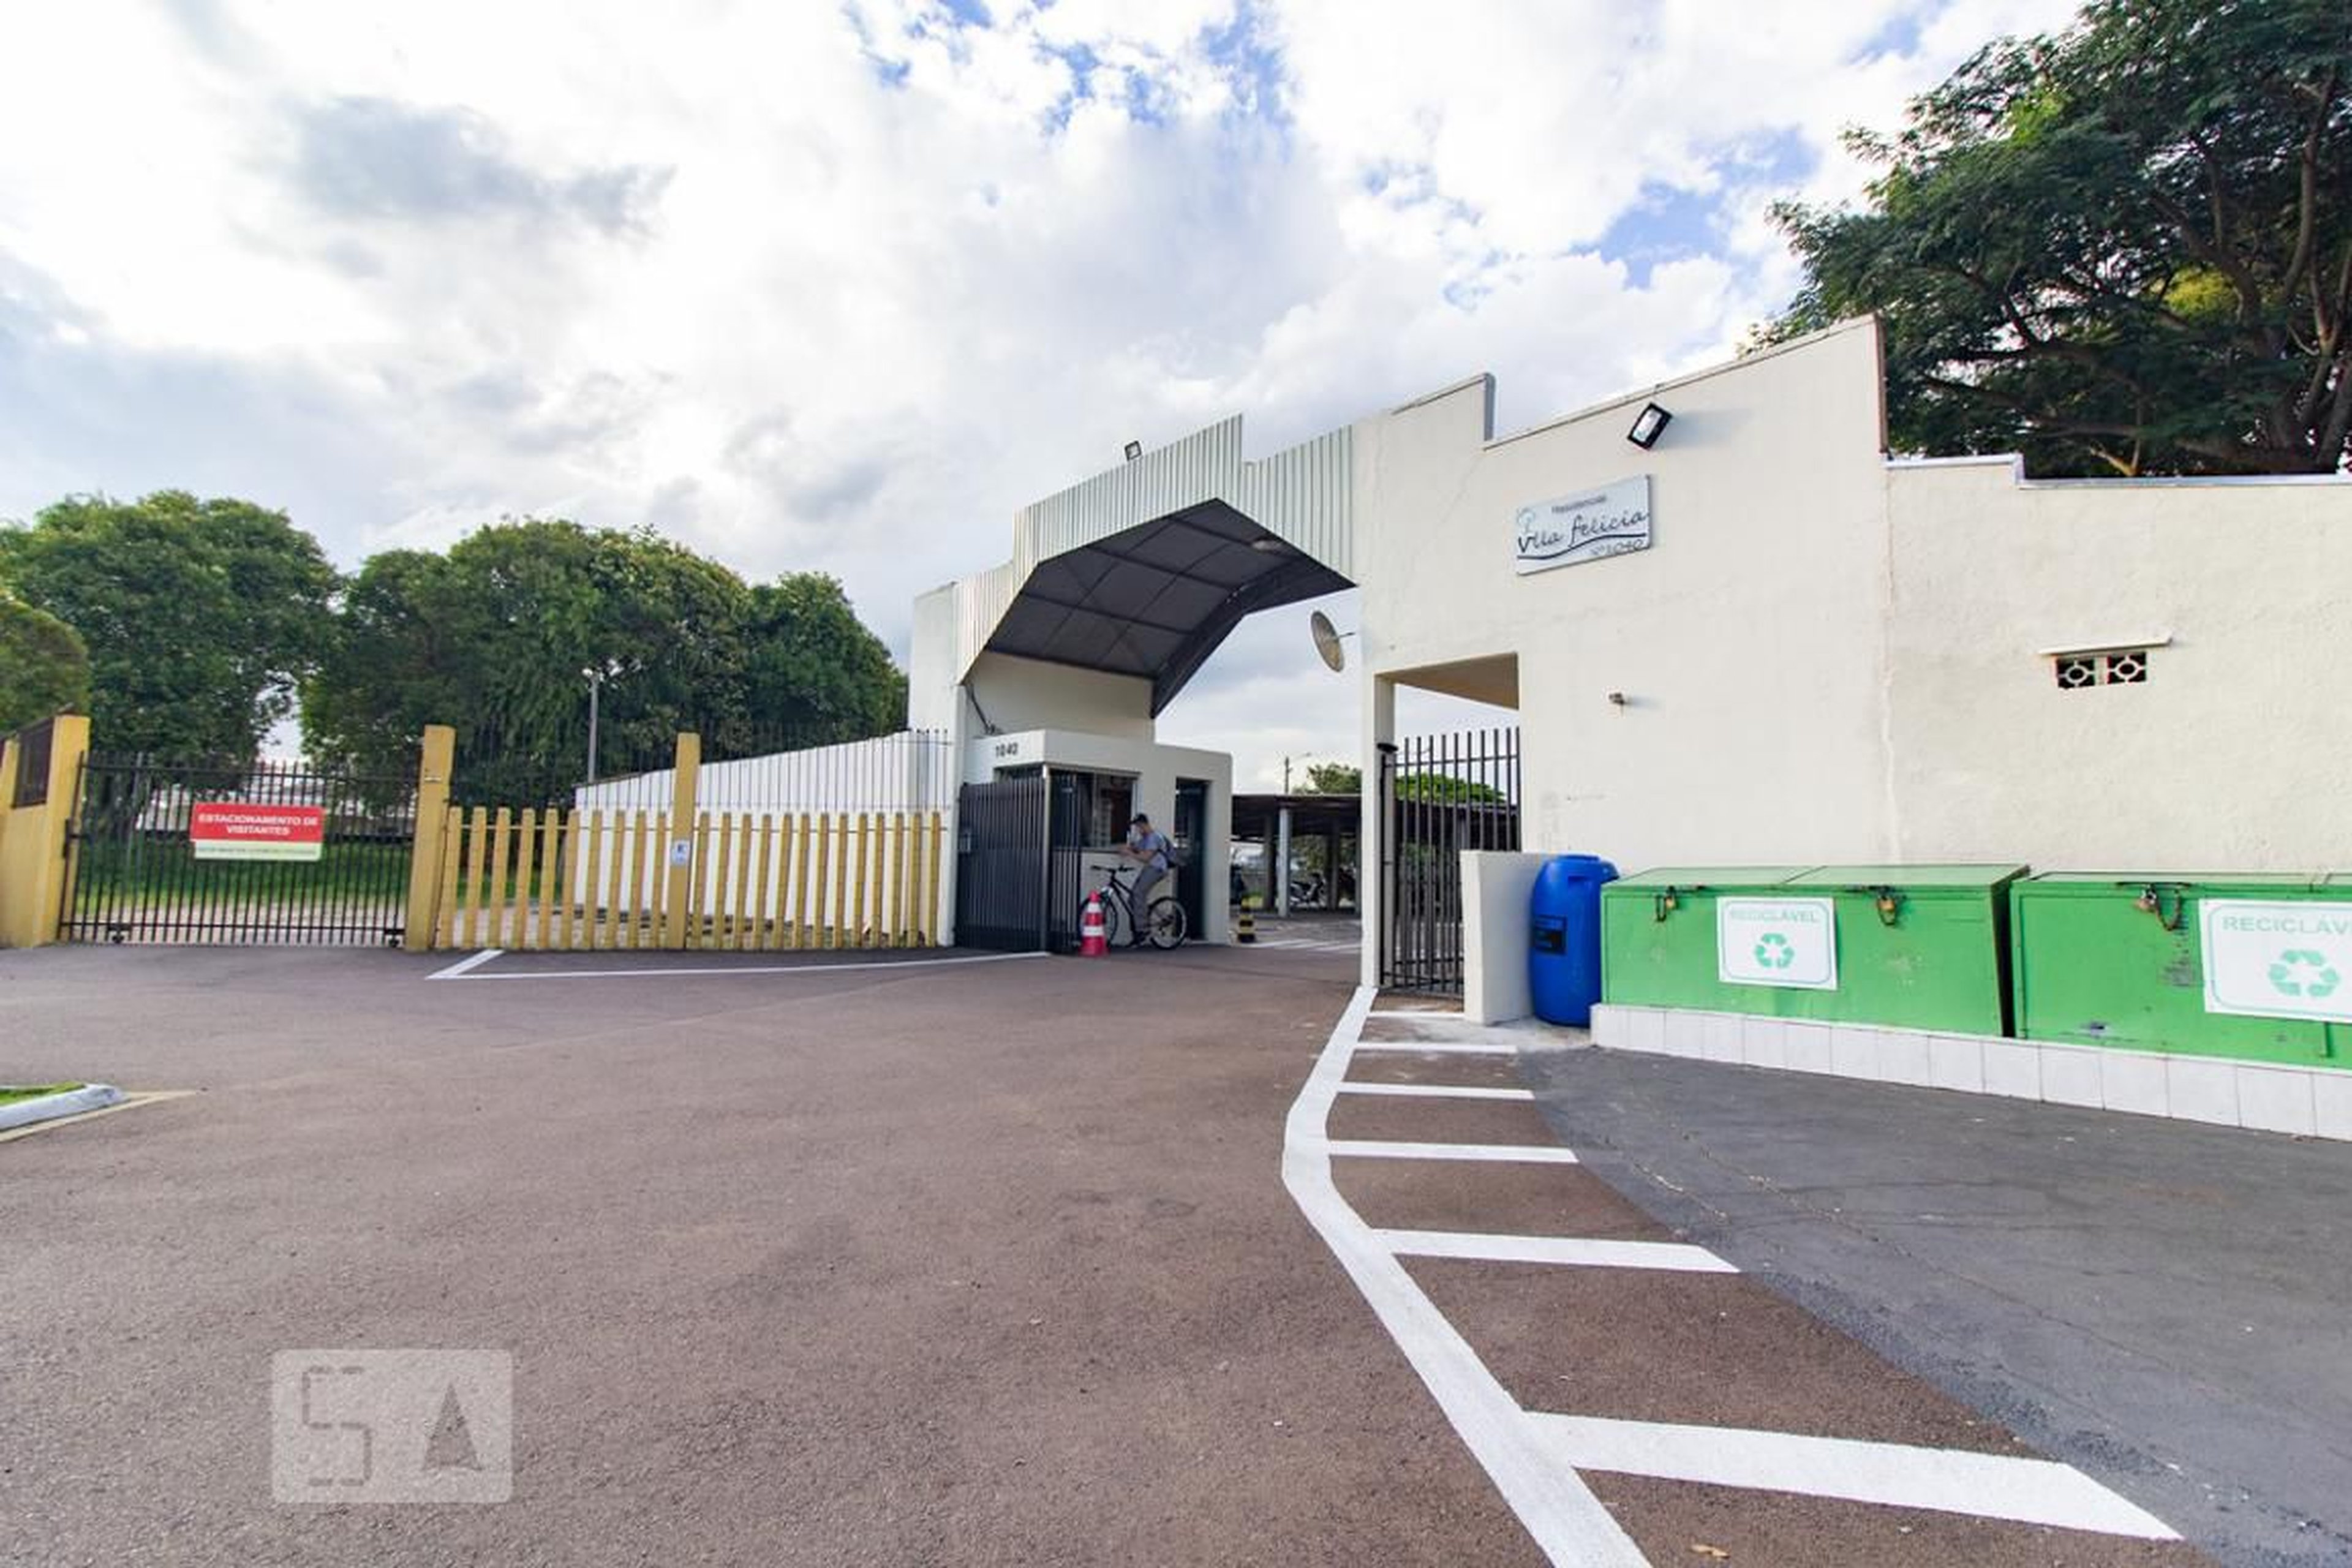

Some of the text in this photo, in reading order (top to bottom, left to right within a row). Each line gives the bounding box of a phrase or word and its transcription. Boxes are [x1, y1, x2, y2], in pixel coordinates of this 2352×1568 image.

[197, 813, 318, 826] ESTACIONAMENTO DE
[226, 826, 290, 836] VISITANTES
